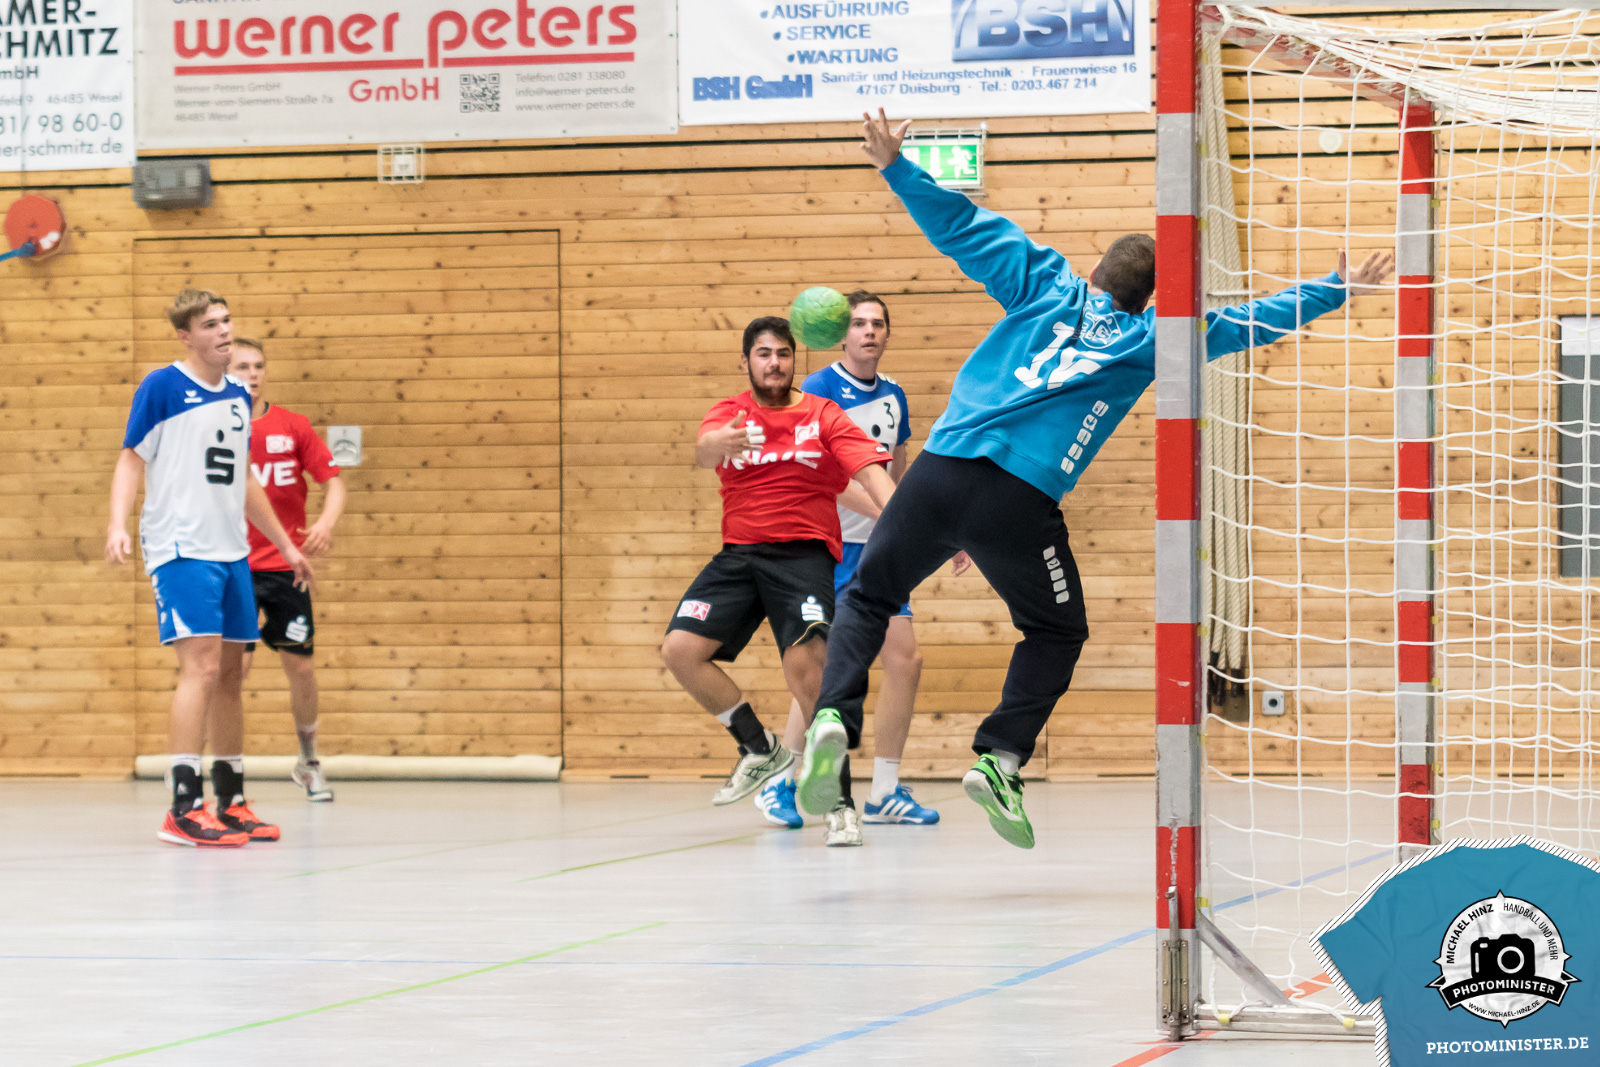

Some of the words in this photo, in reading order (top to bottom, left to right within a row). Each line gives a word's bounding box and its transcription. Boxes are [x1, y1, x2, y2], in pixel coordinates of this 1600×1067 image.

[0, 0, 96, 25] MER-
[771, 0, 910, 19] AUSFÜHRUNG
[174, 12, 399, 59] werner
[428, 0, 637, 68] peters
[786, 24, 872, 41] SERVICE
[977, 0, 1110, 47] BSH
[0, 27, 118, 58] HMITZ
[796, 47, 899, 64] WARTUNG
[821, 72, 868, 83] Sanitär
[873, 71, 898, 81] und
[902, 67, 1012, 82] Heizungstechnik
[1032, 64, 1117, 76] Frauenwiese
[1122, 62, 1137, 73] 16
[248, 82, 281, 91] GmbH
[349, 77, 439, 102] GmbH
[692, 76, 740, 101] BSH
[856, 84, 896, 95] 47167
[900, 82, 960, 95] Duisburg
[1074, 77, 1097, 88] 214
[38, 115, 63, 133] 98
[73, 112, 122, 132] 60-0
[0, 136, 122, 157] er-schmitz.de
[230, 404, 244, 432] 5
[883, 402, 895, 429] 3
